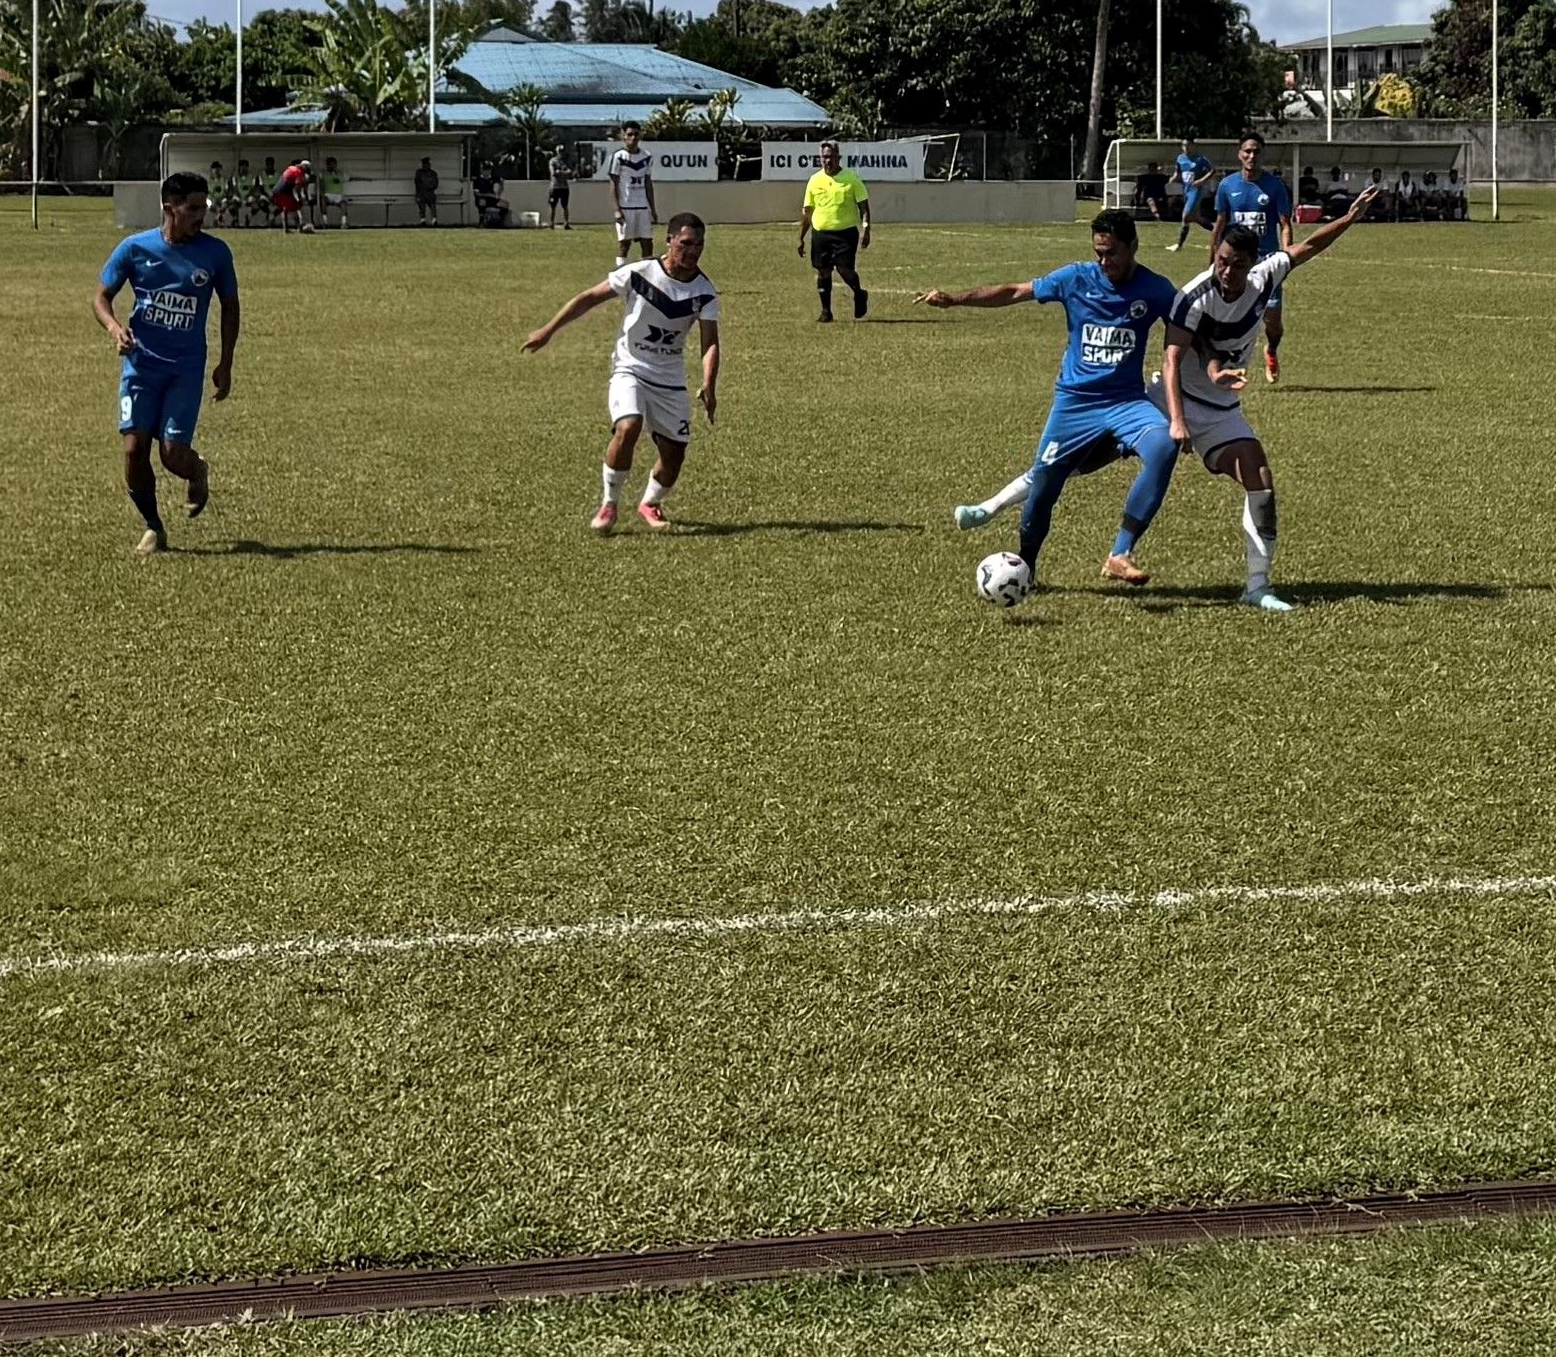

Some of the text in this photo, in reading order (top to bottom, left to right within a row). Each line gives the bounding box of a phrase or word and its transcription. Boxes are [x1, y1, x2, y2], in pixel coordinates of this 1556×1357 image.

[660, 154, 708, 168] QU'UN
[770, 154, 792, 168] ICI
[847, 154, 908, 169] MAHINA
[149, 291, 194, 312] VAIMA
[1085, 325, 1133, 346] VAIMA
